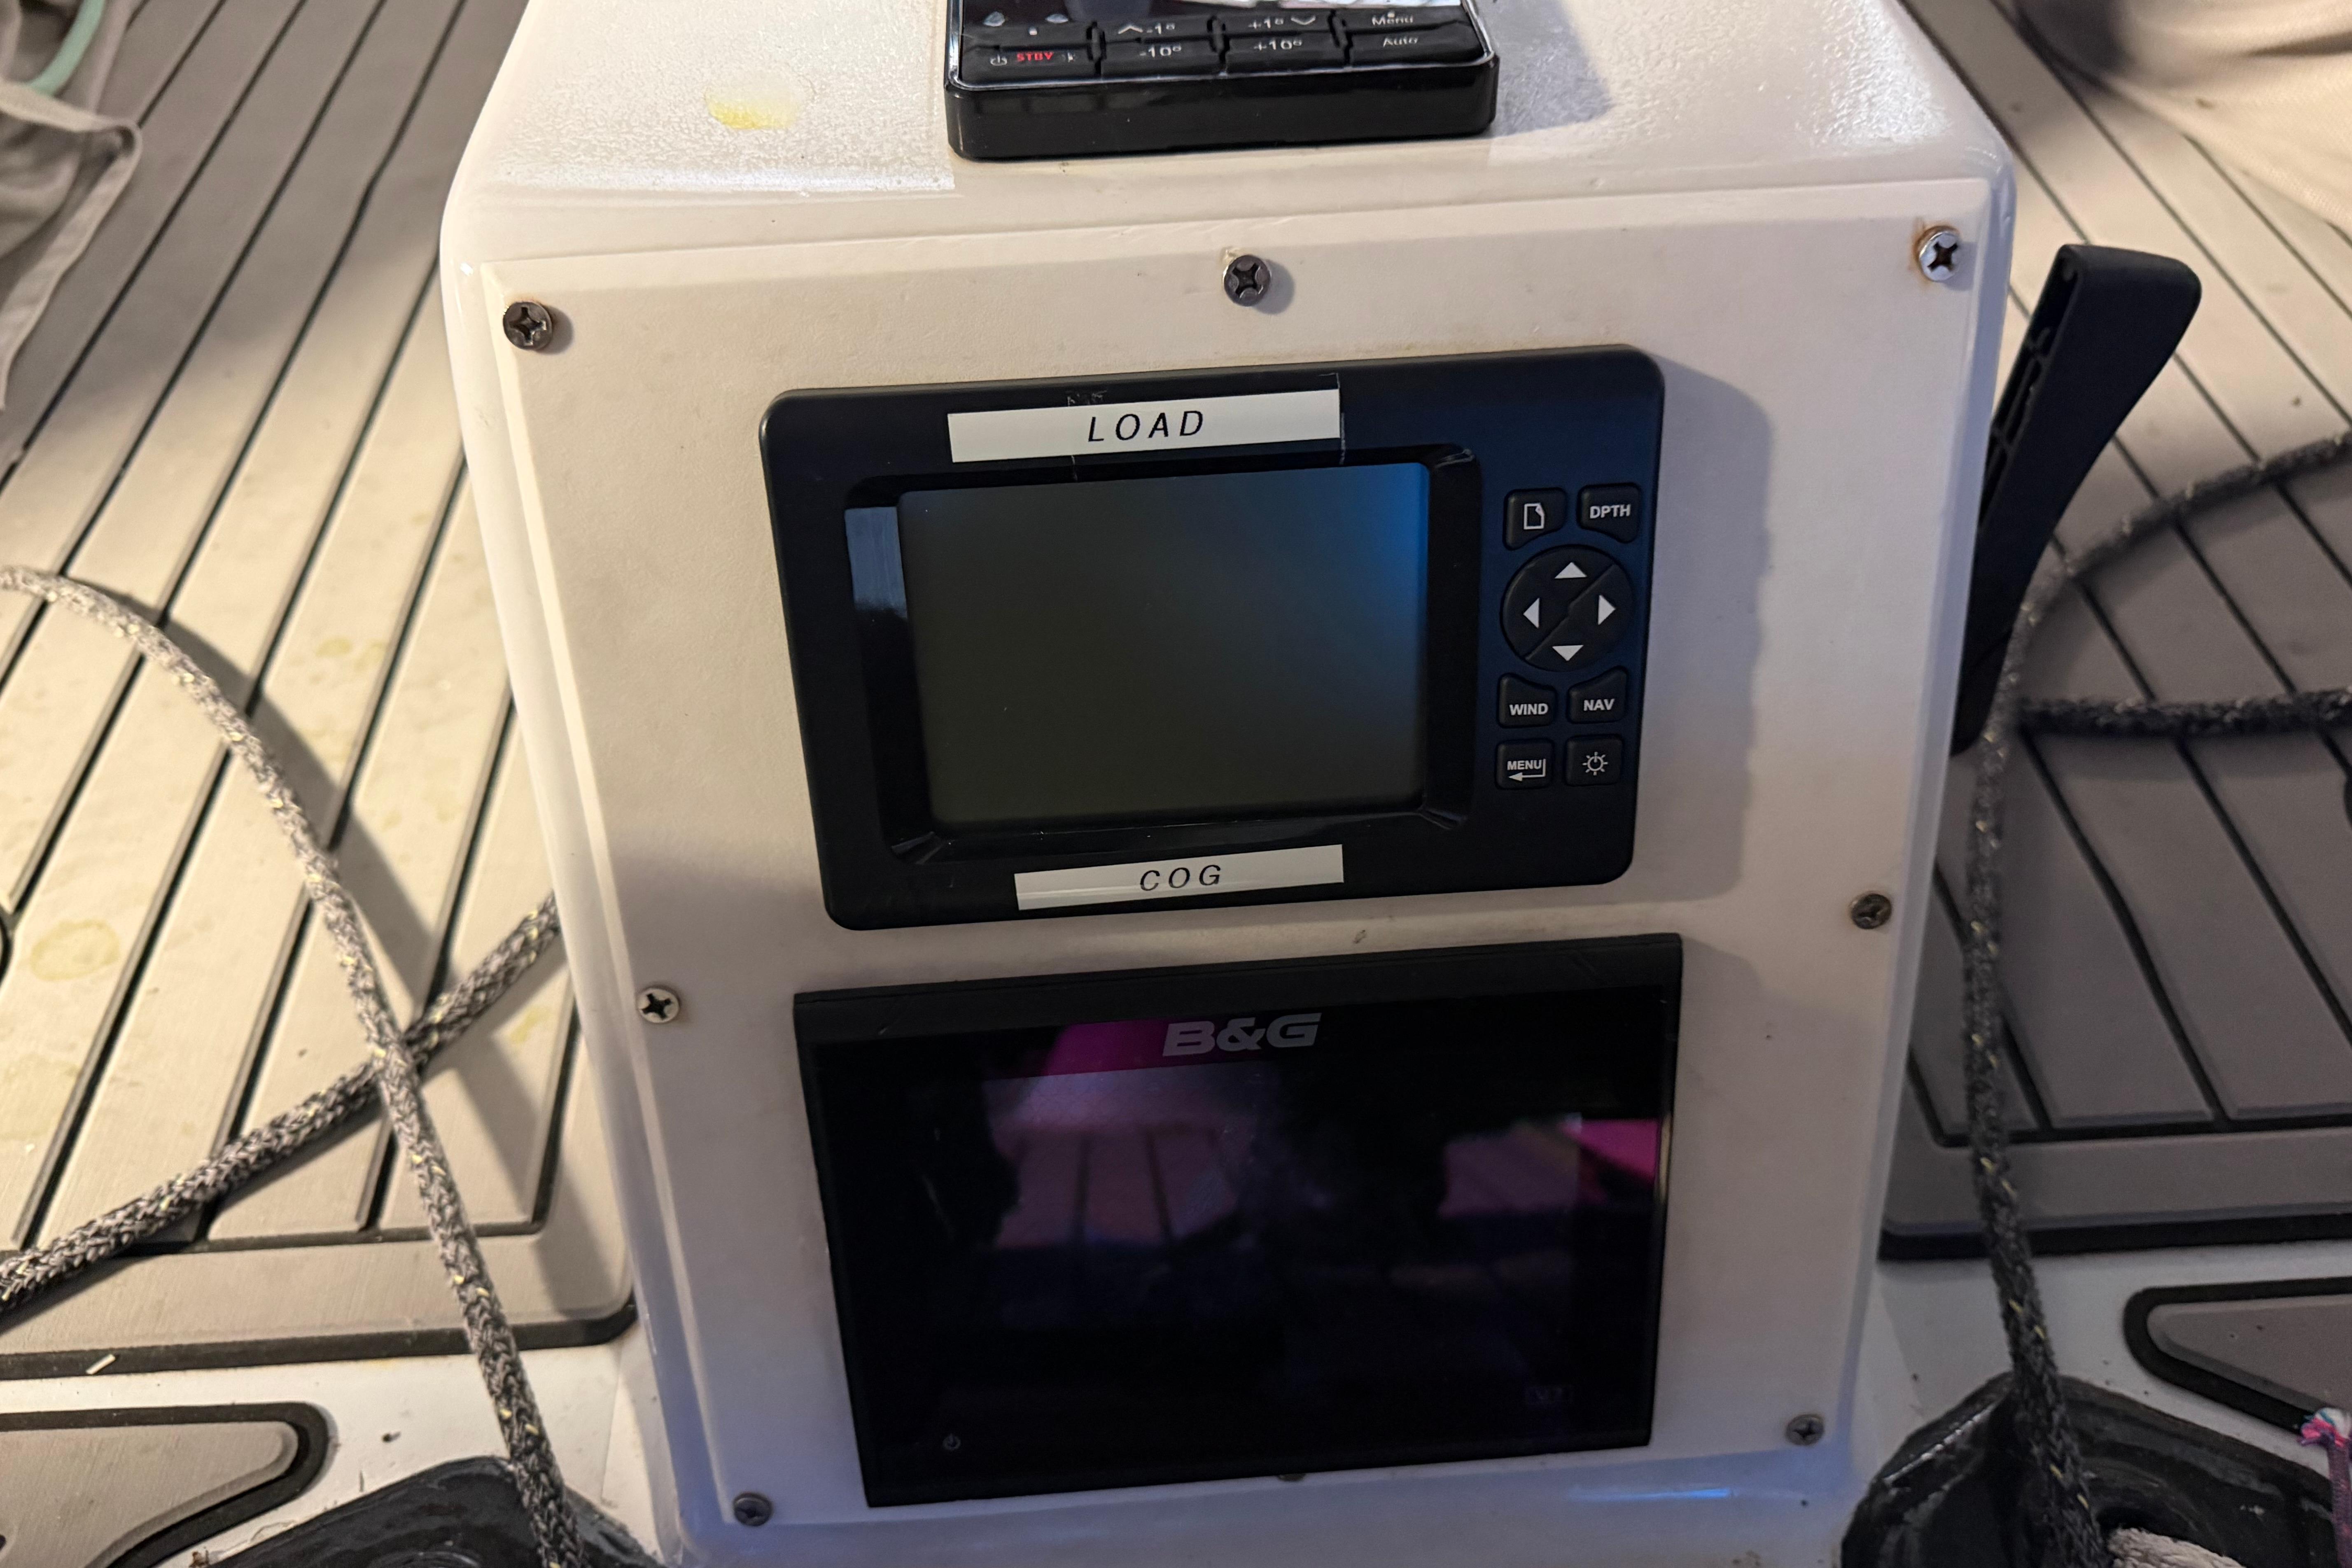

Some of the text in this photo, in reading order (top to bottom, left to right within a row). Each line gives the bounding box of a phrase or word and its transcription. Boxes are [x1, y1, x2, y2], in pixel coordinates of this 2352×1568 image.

[1382, 37, 1419, 48] Auto
[1087, 410, 1203, 442] LOAD
[1589, 504, 1631, 519] DPTH
[1509, 703, 1549, 715] WIND
[1583, 699, 1615, 712] NAV
[1507, 759, 1542, 770] MENU
[1139, 864, 1221, 891] COG
[1162, 1013, 1322, 1057] B&G
